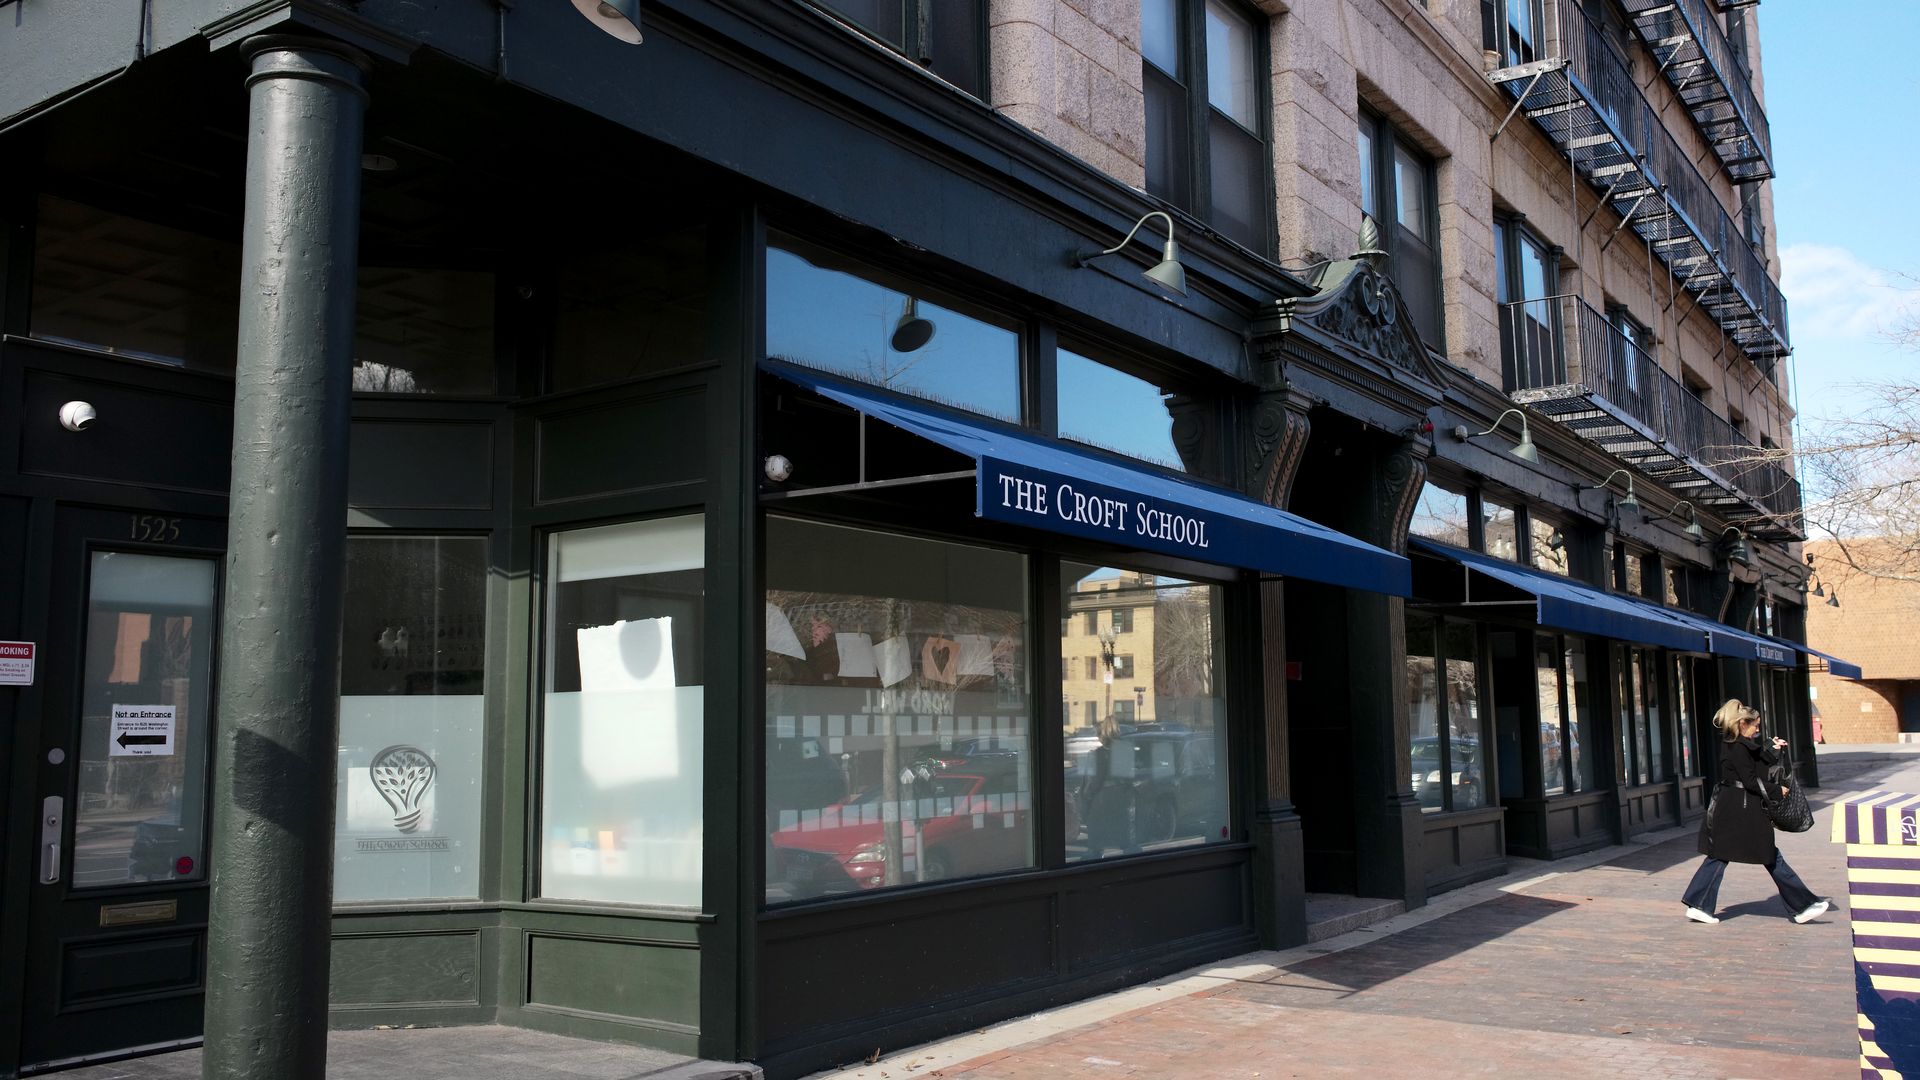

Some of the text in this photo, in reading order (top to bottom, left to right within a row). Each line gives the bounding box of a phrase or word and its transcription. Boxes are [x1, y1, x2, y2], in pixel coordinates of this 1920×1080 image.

[130, 515, 183, 542] 1525
[999, 473, 1209, 548] THE CROFT SCHOOL
